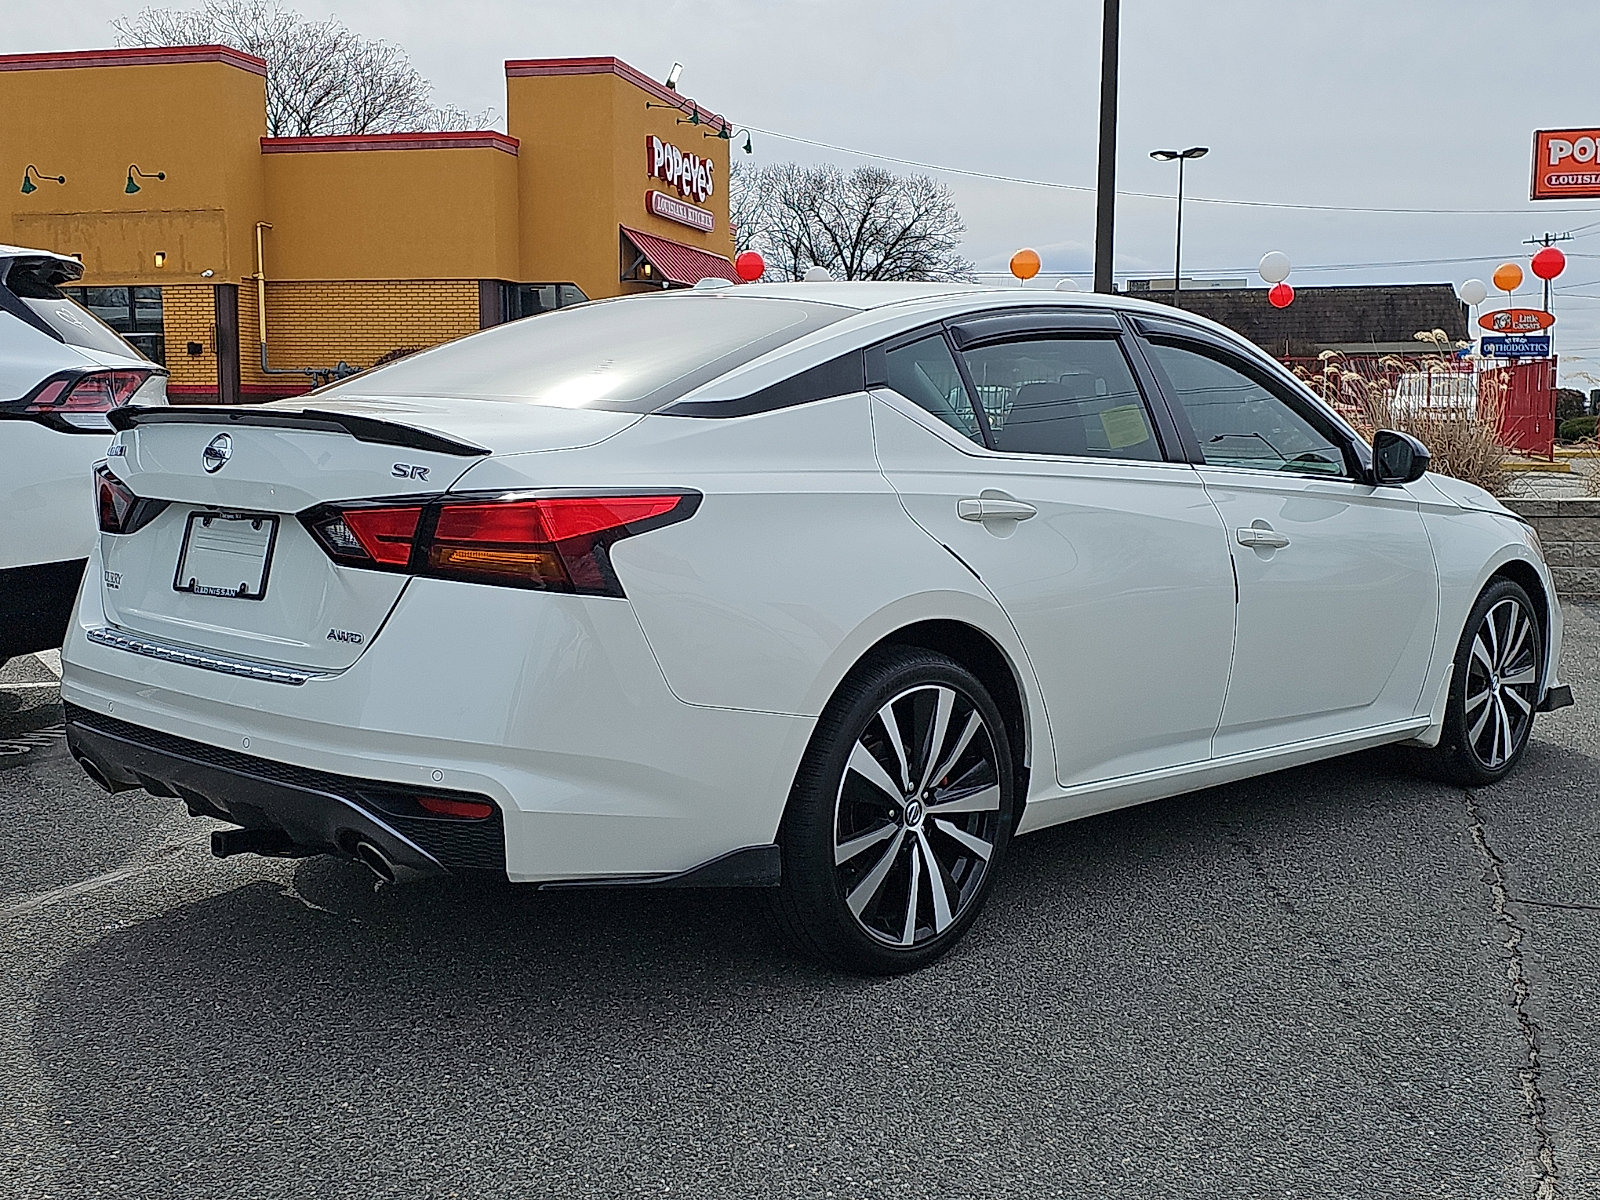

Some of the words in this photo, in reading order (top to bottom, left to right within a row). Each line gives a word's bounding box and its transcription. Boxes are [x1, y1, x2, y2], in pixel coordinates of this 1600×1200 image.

[1548, 137, 1600, 166] PO
[657, 196, 687, 218] LOUISIANA
[1519, 314, 1538, 322] Little
[390, 462, 431, 482] SR
[208, 587, 236, 597] NISSAN
[326, 628, 365, 645] AWD
